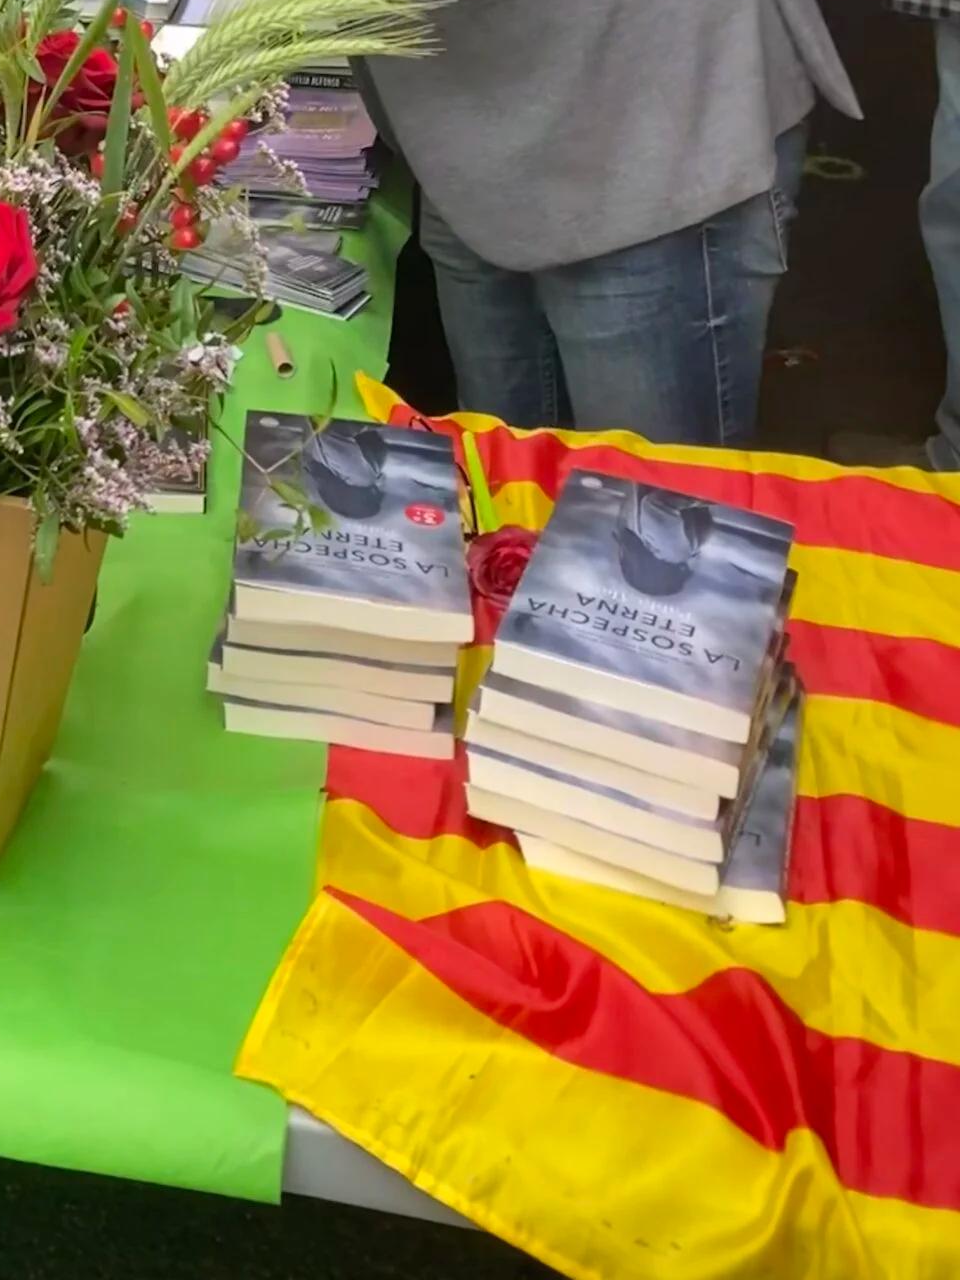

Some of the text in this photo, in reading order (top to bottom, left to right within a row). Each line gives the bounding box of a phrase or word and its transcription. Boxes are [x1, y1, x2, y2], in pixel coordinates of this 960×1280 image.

[255, 537, 450, 578] LA SOSPECHA
[527, 597, 694, 656] SOSPECHA
[576, 592, 696, 638] ETERNA
[703, 648, 741, 672] LA
